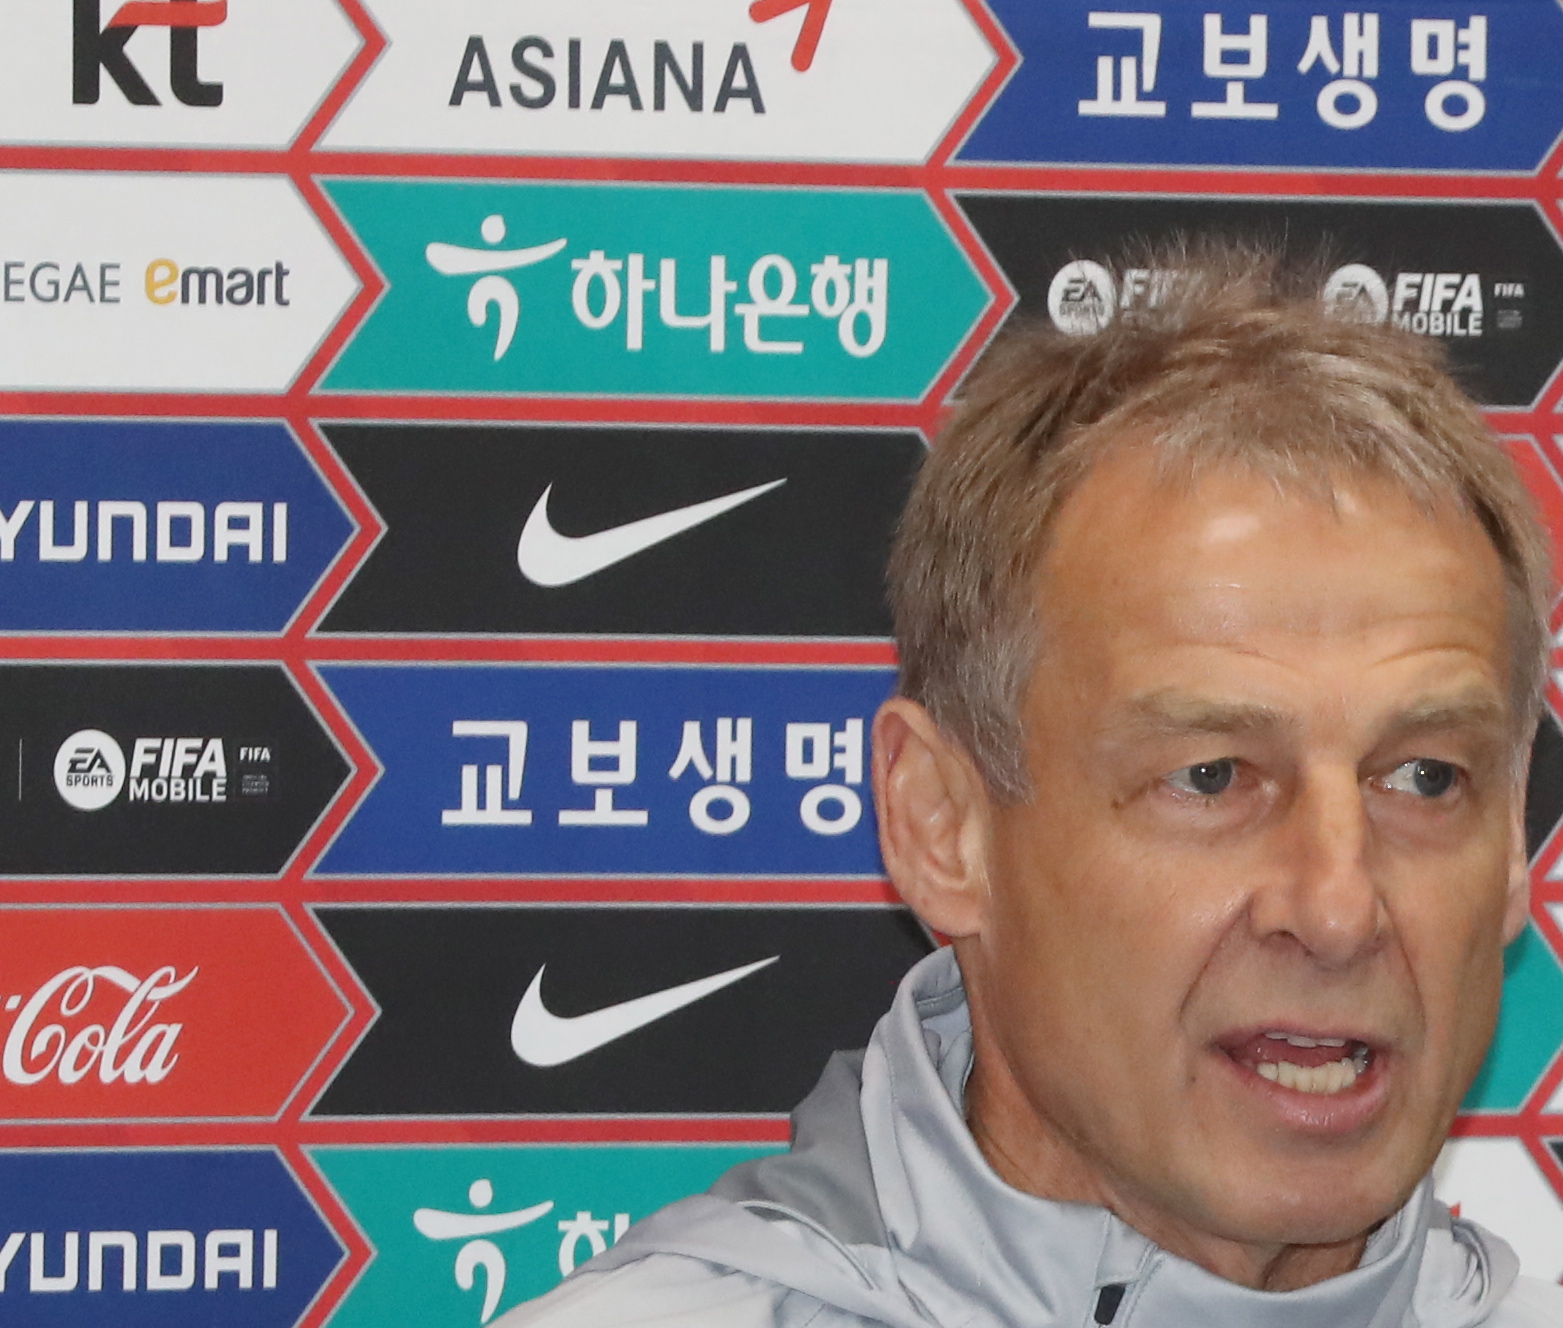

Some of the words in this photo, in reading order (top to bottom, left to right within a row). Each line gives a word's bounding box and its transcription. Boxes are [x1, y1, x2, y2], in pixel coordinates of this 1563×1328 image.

[72, 0, 227, 107] kt
[449, 36, 765, 114] ASIANA
[1078, 12, 1487, 131] 교보생명
[145, 259, 289, 306] emart
[571, 250, 888, 358] 하나은행
[1394, 272, 1483, 311] FIFA
[66, 774, 114, 787] SPORTS
[129, 738, 227, 777] FIFA
[440, 714, 865, 837] 교보생명
[129, 777, 227, 801] MOBILE
